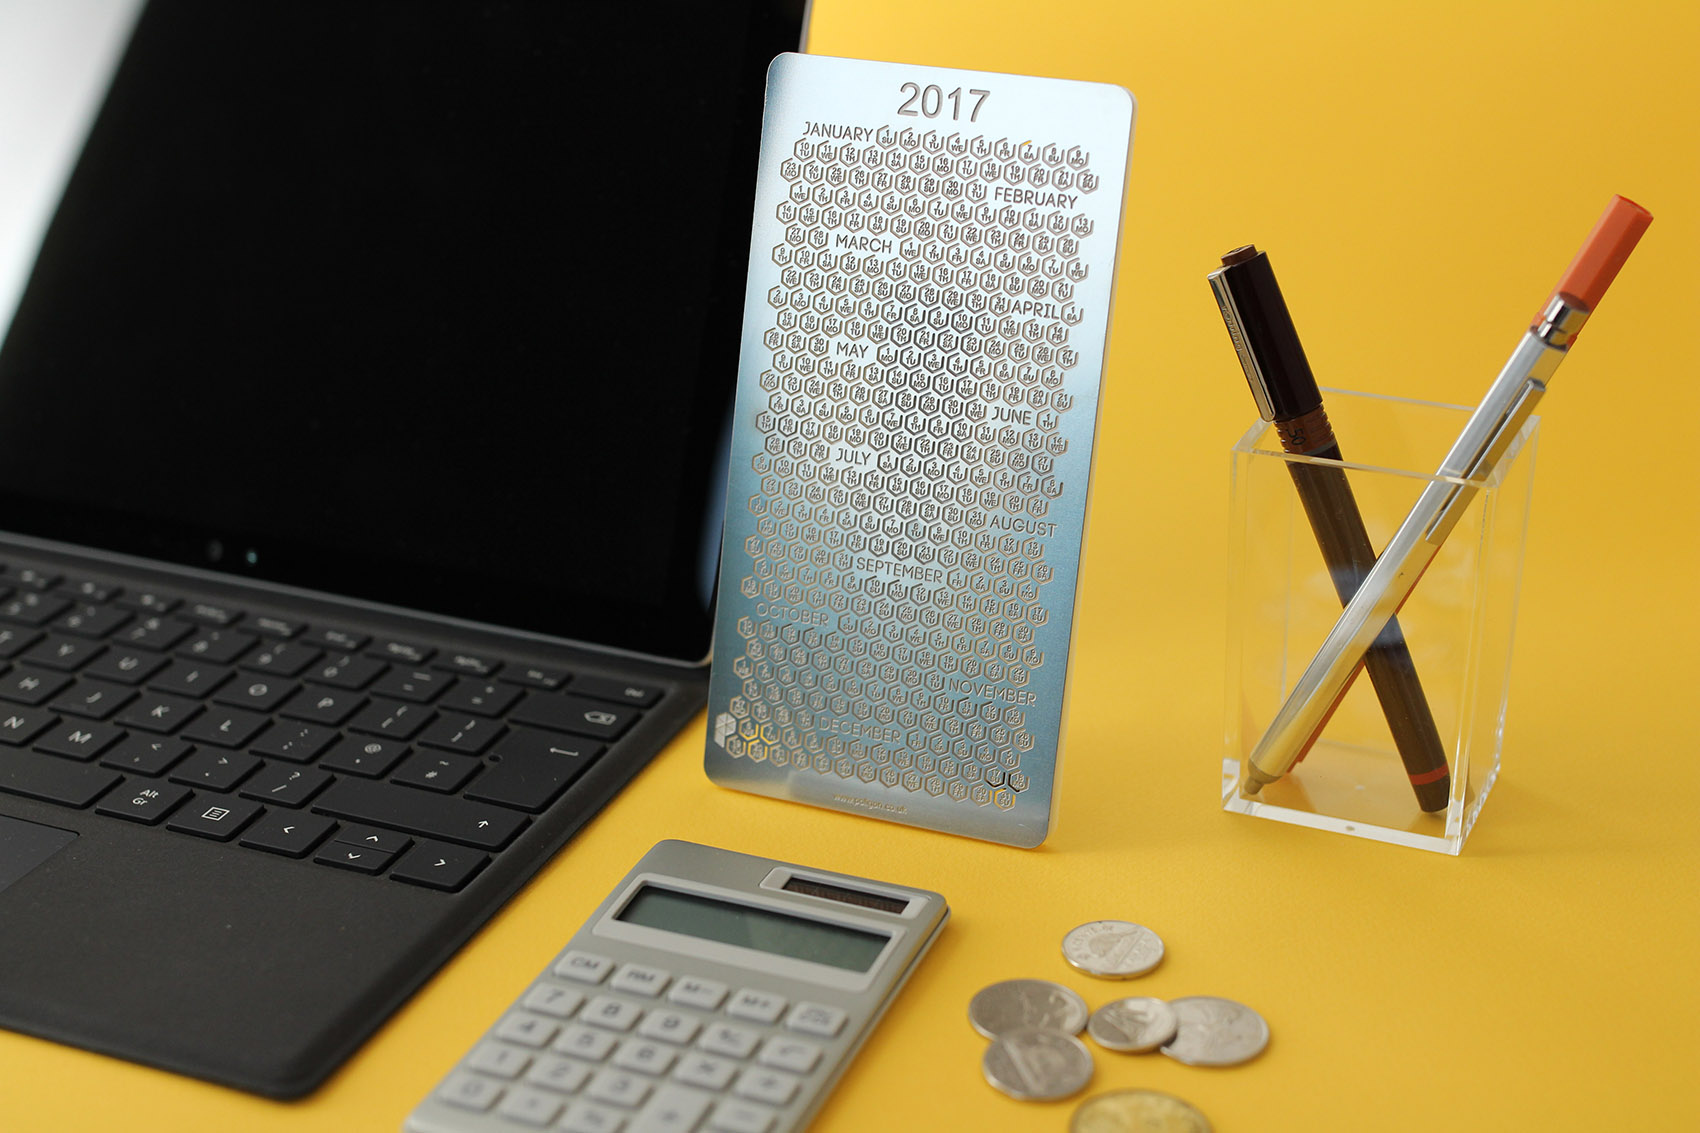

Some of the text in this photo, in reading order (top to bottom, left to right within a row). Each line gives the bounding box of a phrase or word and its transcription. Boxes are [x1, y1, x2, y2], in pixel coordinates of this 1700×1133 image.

[897, 82, 990, 122] 2017
[803, 121, 873, 142] JANUARY
[881, 136, 892, 144] SU
[903, 138, 916, 147] MO
[928, 141, 939, 149] TU
[950, 143, 963, 152] WE
[799, 149, 809, 157] TU
[976, 146, 987, 154] TH
[999, 148, 1010, 157] FR
[820, 151, 833, 159] WE
[845, 154, 855, 162] TH
[1023, 151, 1034, 159] SA
[867, 156, 878, 164] FR
[891, 159, 901, 167] SA
[914, 161, 925, 170] SU
[936, 164, 949, 172] MO
[961, 167, 972, 175] TU
[793, 191, 805, 200] WE
[817, 194, 828, 202] TH
[994, 186, 1078, 210] FEBRUARY
[839, 197, 850, 205] FR
[863, 199, 873, 208] SA
[886, 202, 897, 210] SU
[835, 234, 892, 254] MARCH
[903, 248, 916, 256] WE
[928, 251, 939, 259] TH
[951, 254, 962, 262] FR
[975, 257, 985, 265] SA
[999, 260, 1010, 268] SU
[794, 299, 806, 307] MO
[818, 302, 828, 310] TU
[839, 305, 851, 313] WE
[863, 308, 874, 316] TH
[1011, 299, 1060, 319] APRIL
[886, 311, 896, 319] FR
[909, 314, 919, 322] SA
[836, 341, 869, 359] MAY
[880, 353, 893, 362] MO
[905, 357, 915, 365] TU
[927, 360, 939, 368] WE
[952, 363, 962, 372] TH
[975, 366, 985, 375] FR
[818, 409, 829, 417] SU
[840, 412, 853, 420] MO
[991, 406, 1031, 425] JUNE
[864, 415, 874, 424] TU
[885, 418, 898, 427] WE
[910, 422, 921, 430] TH
[933, 425, 943, 434] FR
[1286, 427, 1306, 445] 50
[835, 447, 871, 466] JULY
[882, 461, 892, 469] SA
[905, 464, 916, 473] SU
[927, 468, 940, 476] MO
[952, 471, 962, 480] TU
[974, 475, 986, 483] WE
[989, 514, 1057, 538] AUGUST
[856, 556, 943, 584] SEPTEMBER
[755, 602, 828, 627] OCTOBER
[19, 677, 39, 690] H
[948, 678, 1036, 707] NOVEMBER
[152, 705, 170, 718] K
[3, 716, 24, 729] N
[220, 720, 232, 732] L
[819, 716, 901, 745] DECEMBER
[68, 730, 92, 744] M
[140, 789, 159, 798] Alt
[132, 797, 148, 805] Gr
